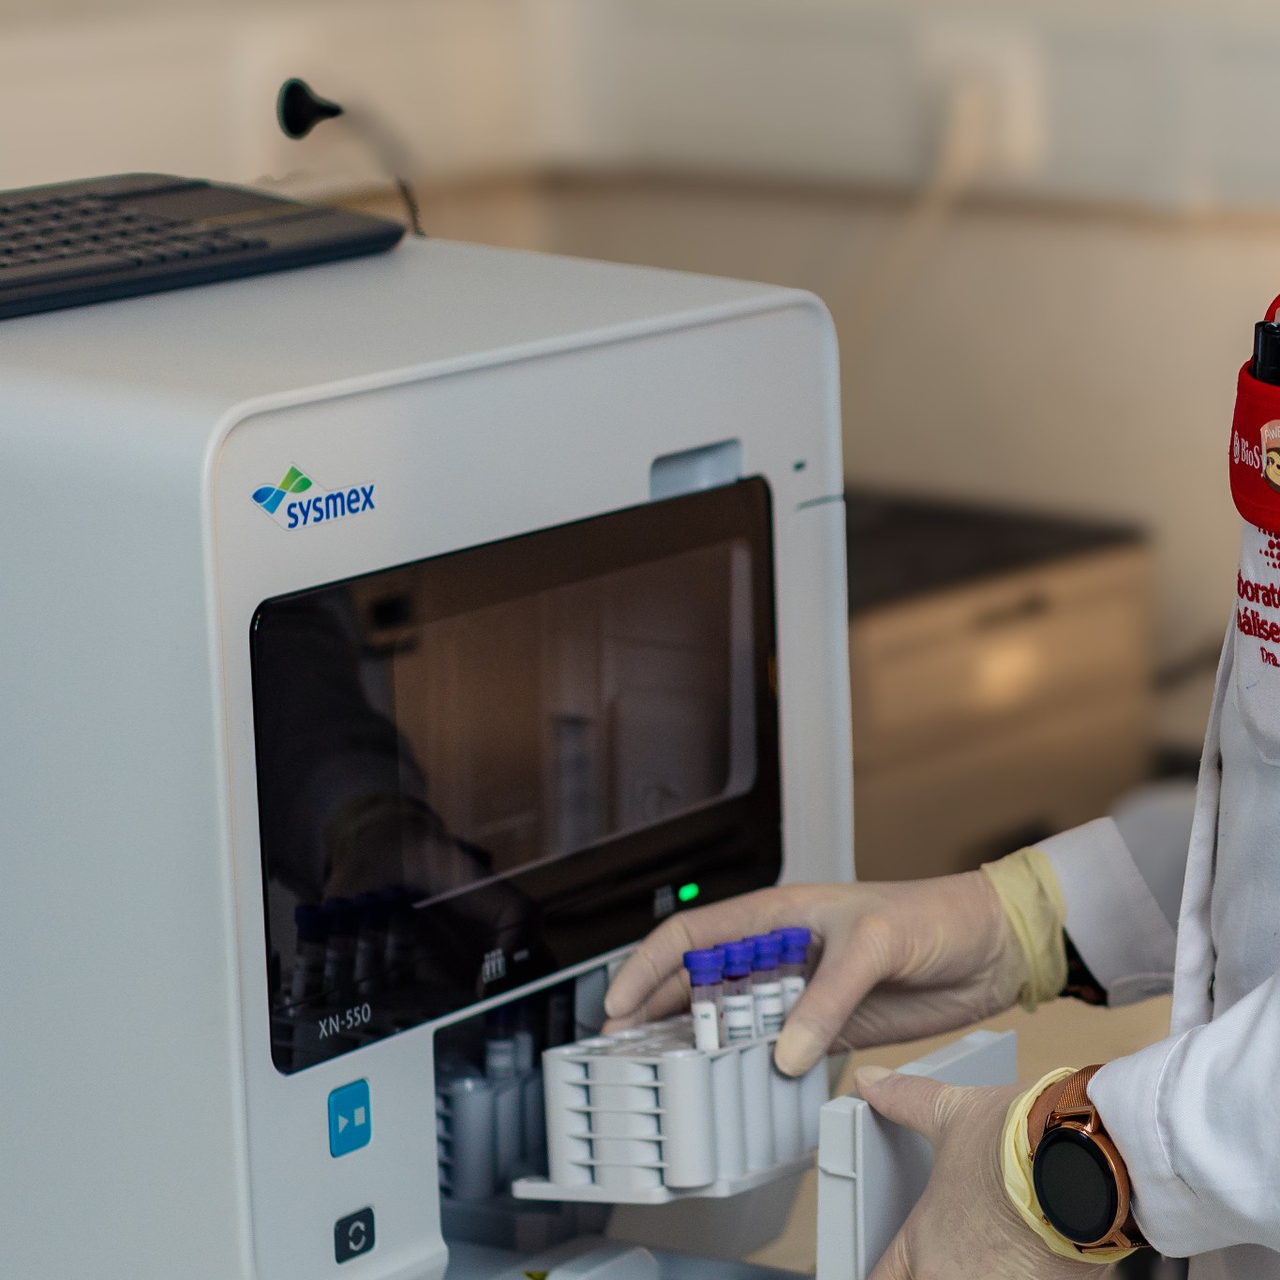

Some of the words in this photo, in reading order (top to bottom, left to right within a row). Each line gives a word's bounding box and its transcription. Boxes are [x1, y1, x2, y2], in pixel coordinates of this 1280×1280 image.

[1241, 437, 1263, 471] BioS
[286, 484, 376, 529] sysmex
[1260, 646, 1280, 668] Dra.
[318, 1002, 372, 1040] XN-550
